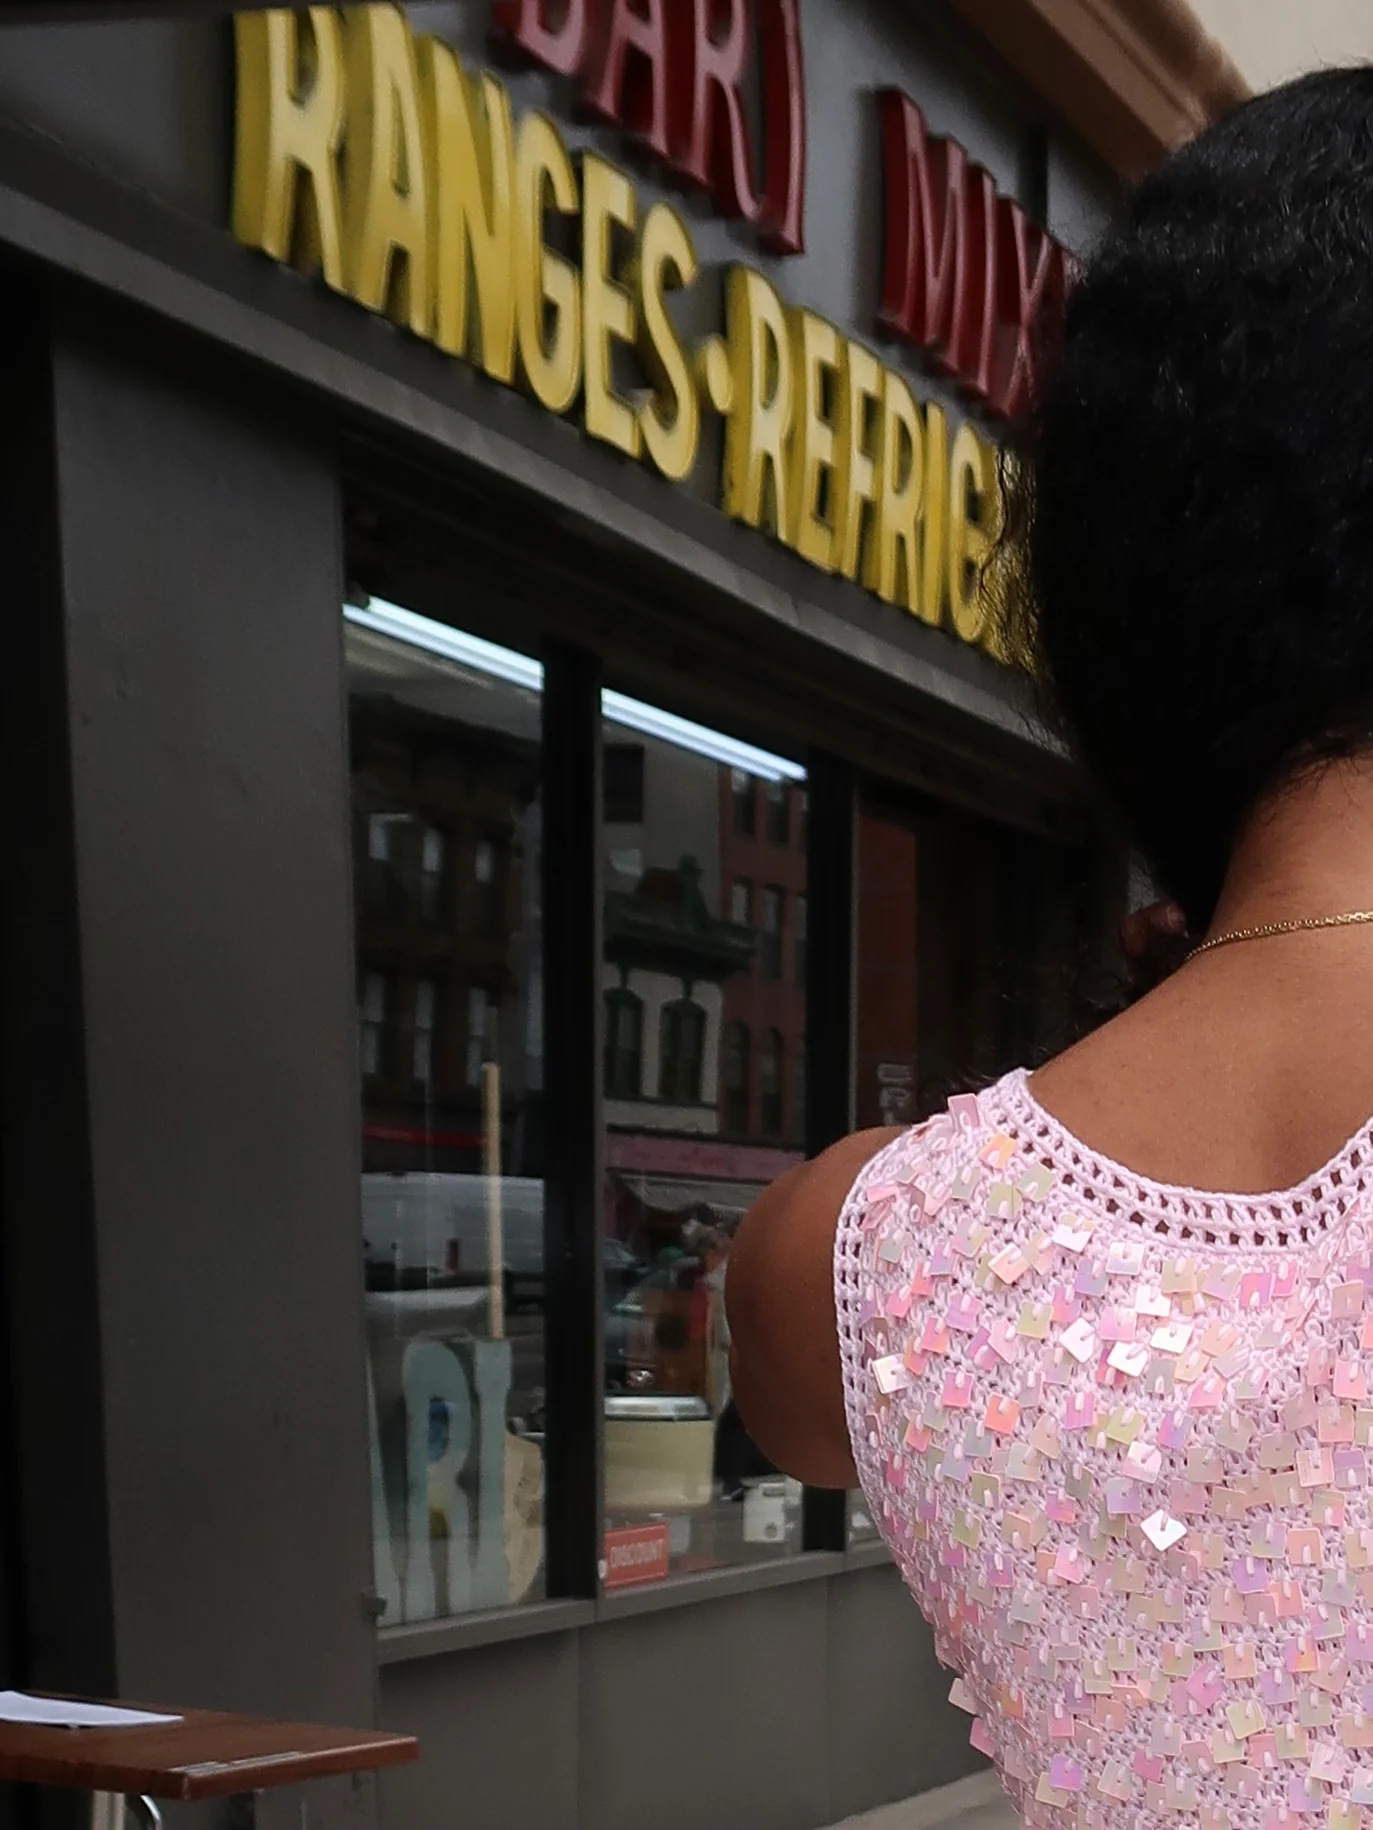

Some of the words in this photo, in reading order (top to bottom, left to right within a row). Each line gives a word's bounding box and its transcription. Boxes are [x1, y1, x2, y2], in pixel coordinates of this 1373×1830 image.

[232, 6, 698, 481] RANGES
[726, 262, 1030, 668] REFRIG
[496, 0, 803, 253] ARI
[879, 84, 1072, 418] MIX
